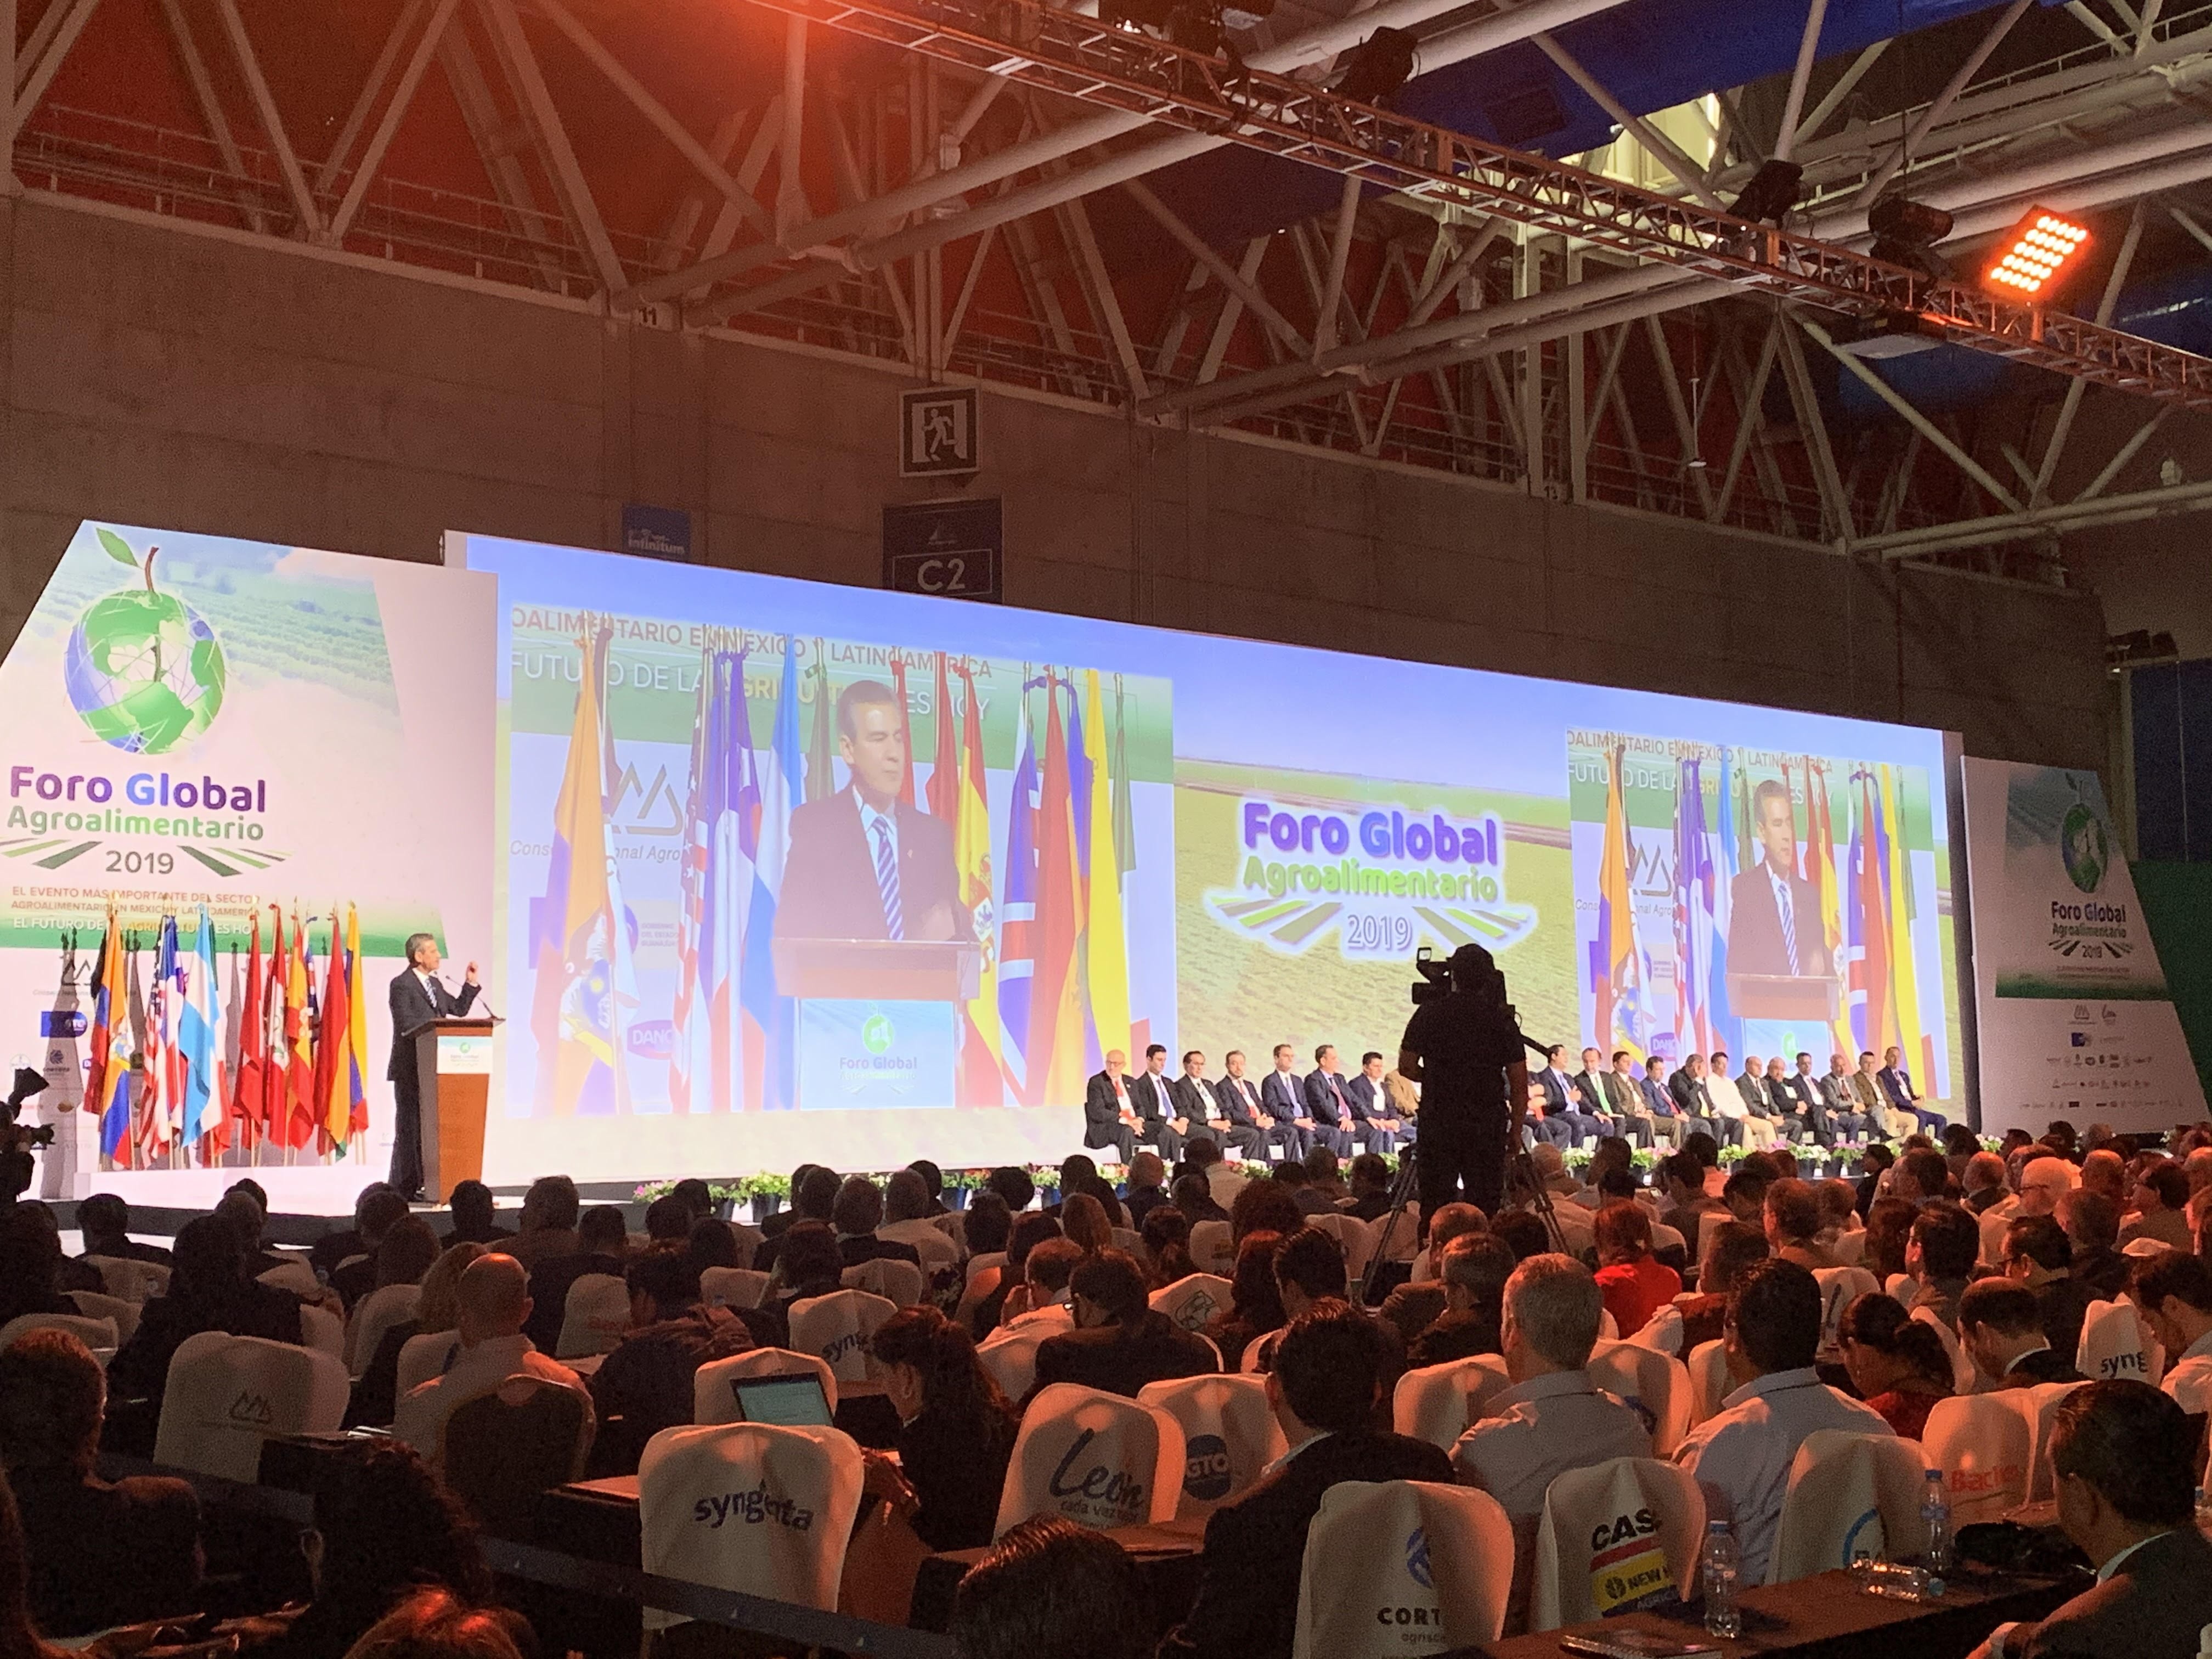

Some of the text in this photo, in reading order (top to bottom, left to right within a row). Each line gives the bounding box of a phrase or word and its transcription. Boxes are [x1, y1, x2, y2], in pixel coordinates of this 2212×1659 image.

[917, 558, 966, 591] C2
[634, 663, 669, 690] DE
[10, 765, 267, 813] Foro Global
[1638, 770, 1658, 789] DE
[7, 805, 264, 841] Agroalimentario
[1243, 803, 1498, 865] Foro Global
[105, 850, 174, 874] 2019
[1243, 855, 1497, 901] Agroalimentario
[13, 886, 27, 896] EL
[30, 887, 79, 898] EVENTO
[13, 918, 27, 928] EL
[31, 918, 84, 930] FUTURO
[2051, 900, 2126, 923] Foro Global
[1346, 914, 1413, 950] 2019
[840, 1056, 917, 1070] Foro Global
